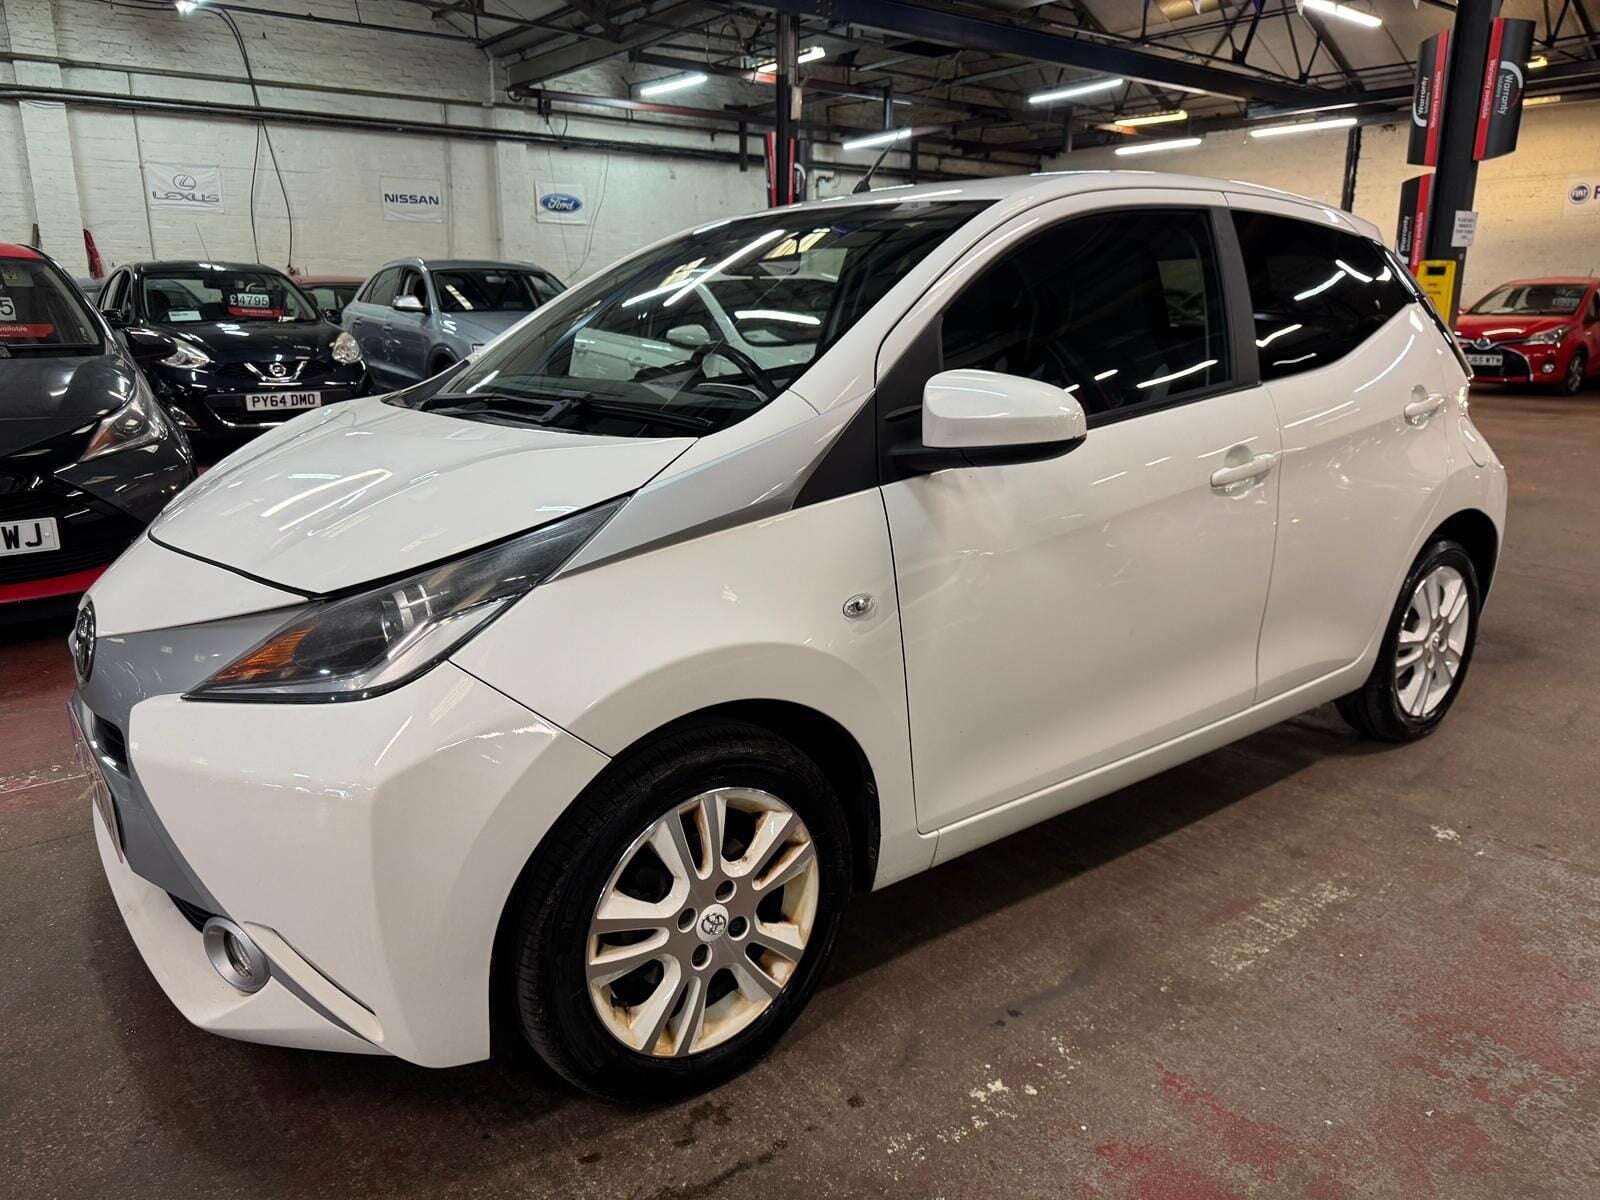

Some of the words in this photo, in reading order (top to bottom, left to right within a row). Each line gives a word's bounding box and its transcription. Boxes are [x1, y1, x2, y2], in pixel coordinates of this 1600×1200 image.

[152, 192, 220, 202] LEXUS
[384, 193, 439, 206] NISSAN
[229, 294, 269, 306] £4795
[251, 395, 287, 408] PY64
[291, 394, 315, 406] DMO
